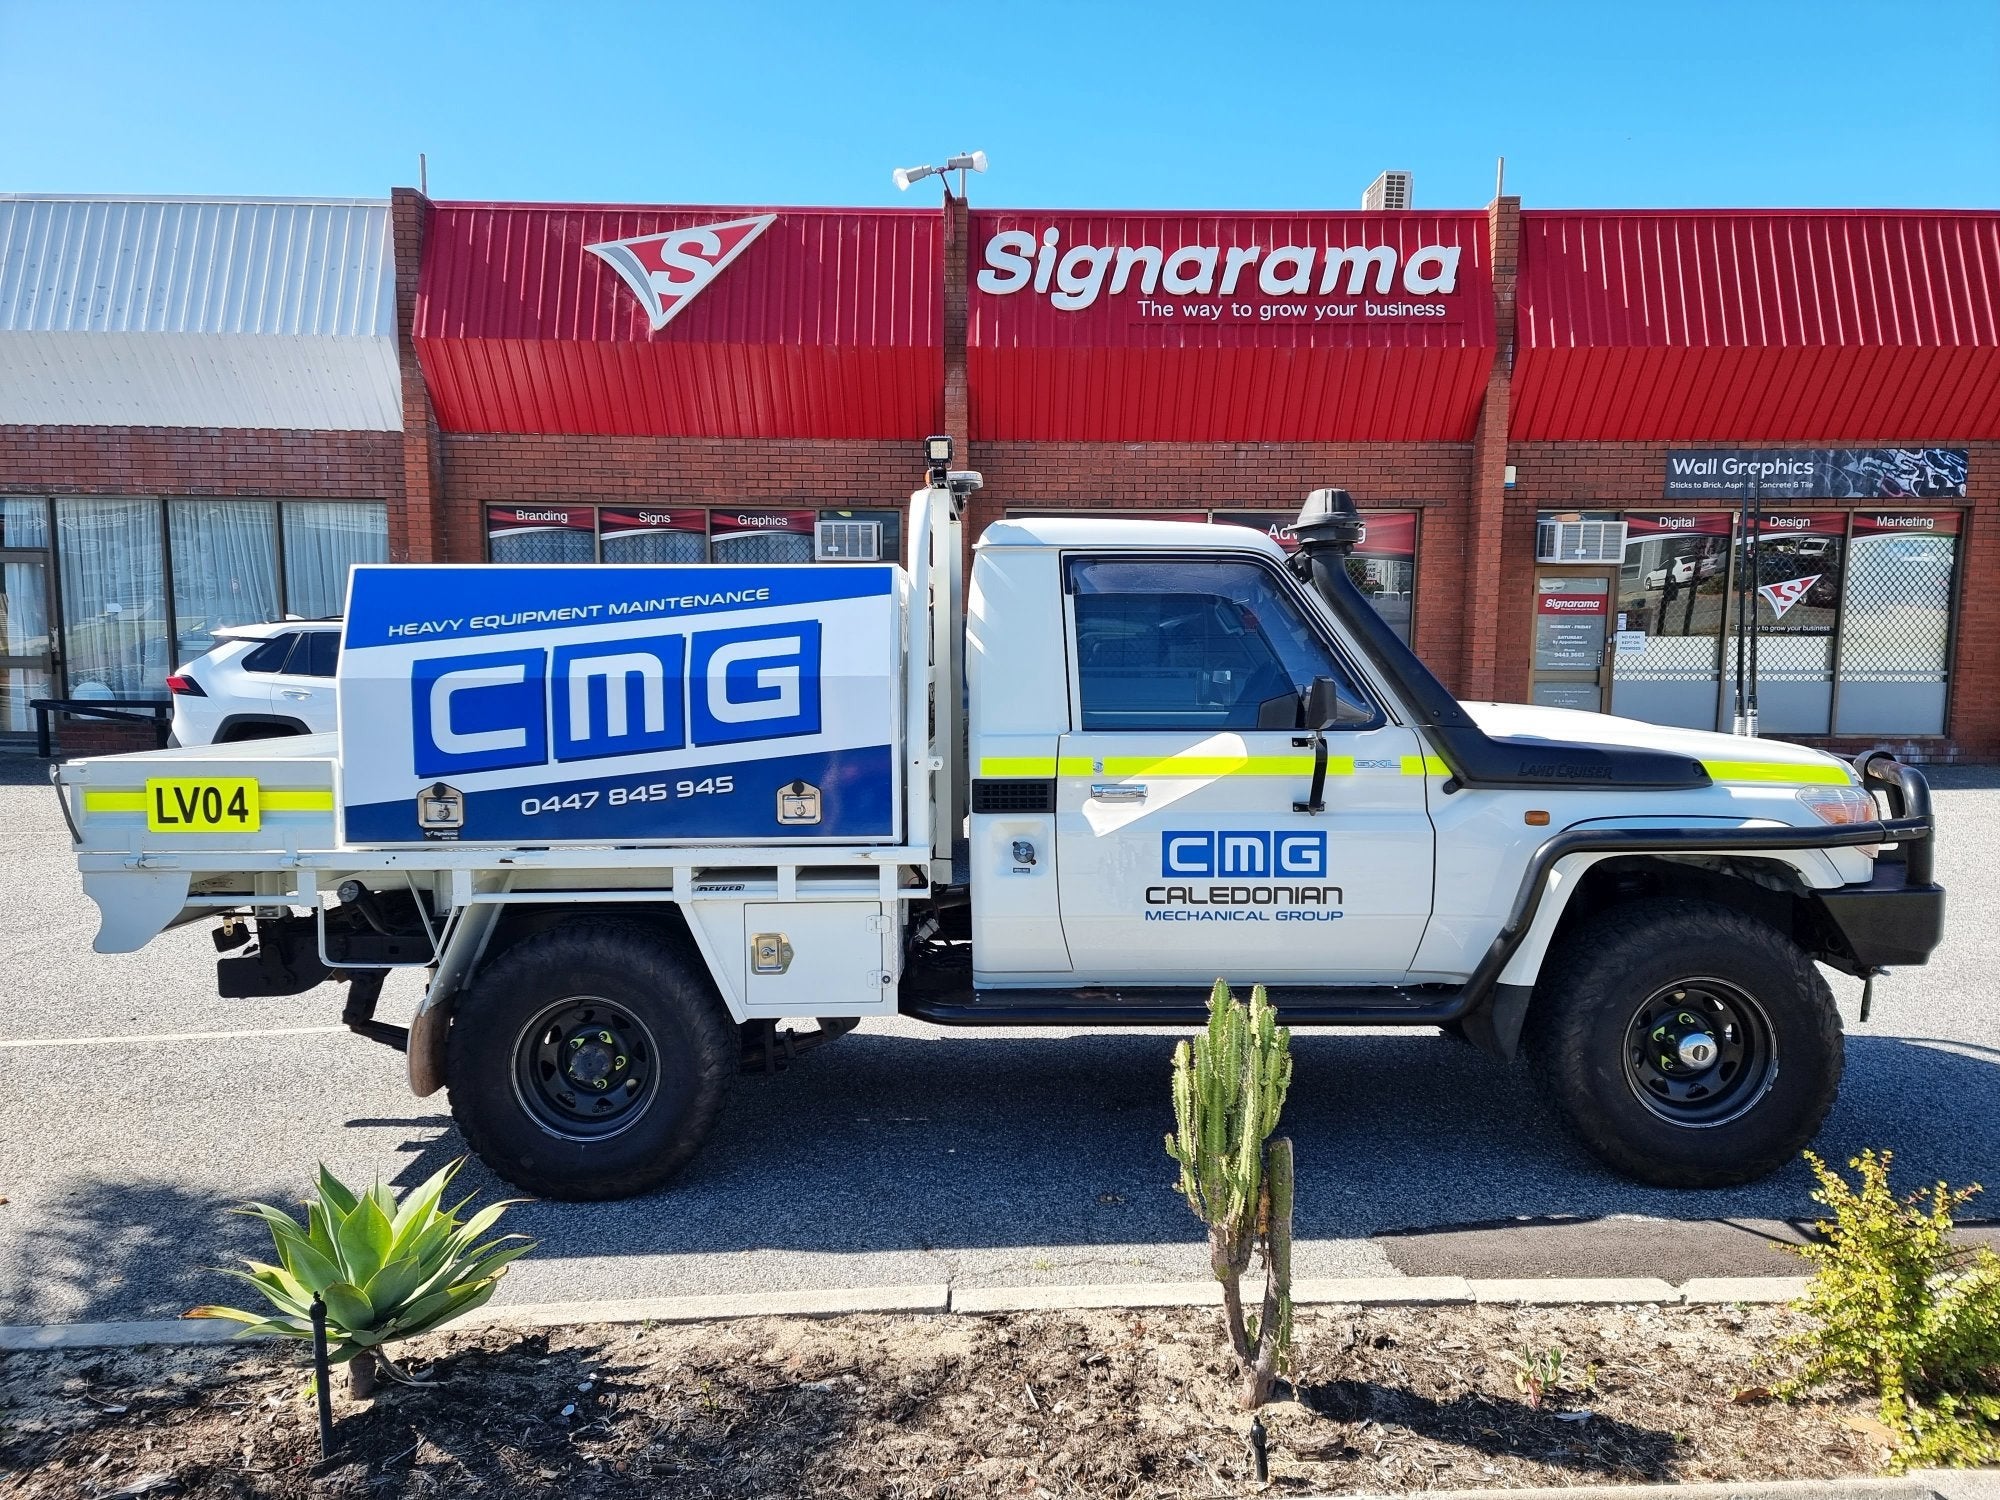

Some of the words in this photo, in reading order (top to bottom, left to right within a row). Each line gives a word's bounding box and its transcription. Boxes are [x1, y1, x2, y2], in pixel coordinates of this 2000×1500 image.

[976, 226, 1462, 311] Signarama
[1137, 300, 1174, 317] The
[1182, 304, 1223, 322] way
[1231, 302, 1252, 317] to
[1259, 304, 1308, 322] grow
[1314, 304, 1358, 322] your
[1365, 300, 1446, 317] business
[1672, 458, 1718, 475] Wall
[1722, 457, 1815, 479] Graphics
[1670, 481, 1693, 489] Sticks
[1800, 481, 1814, 489] Tile
[516, 509, 568, 525] Branding
[638, 511, 671, 526] Signs
[737, 513, 788, 528] Graphics
[1658, 516, 1695, 530] Digital
[1770, 516, 1811, 530] Design
[1876, 515, 1935, 530] Marketing
[1545, 598, 1600, 609] Signarama
[388, 617, 464, 638] HEAVY
[469, 604, 603, 630] EQUIPMENT
[608, 587, 770, 616] MAINTENANCE
[1761, 624, 1770, 632] to
[1769, 625, 1787, 633] grow
[1787, 625, 1801, 633] your
[1802, 624, 1831, 632] business
[429, 635, 801, 756] CMG
[1353, 759, 1401, 769] GXL
[1556, 762, 1614, 780] CRUISER
[520, 790, 600, 817] 0447
[608, 783, 668, 806] 845
[676, 775, 734, 798] 945
[156, 786, 249, 824] LV04
[1168, 836, 1321, 873] CMG
[1145, 886, 1344, 905] CALEDONIAN
[1144, 910, 1271, 922] MECHANICAL
[1275, 910, 1344, 922] GROUP
